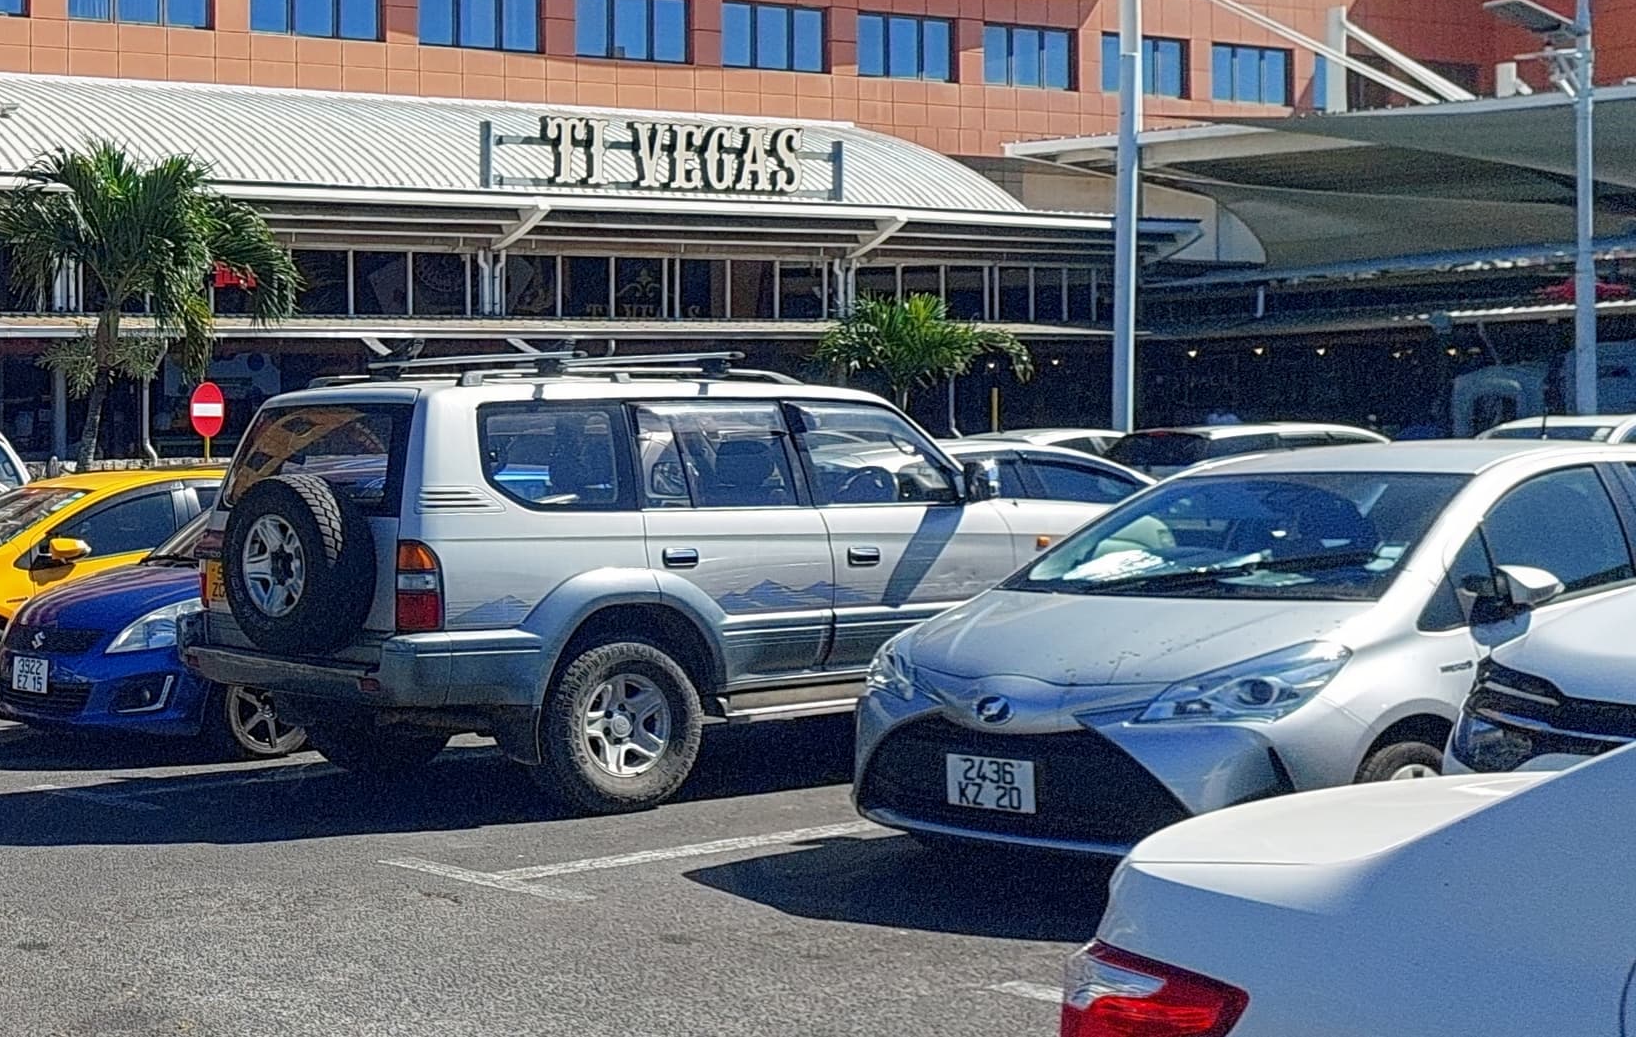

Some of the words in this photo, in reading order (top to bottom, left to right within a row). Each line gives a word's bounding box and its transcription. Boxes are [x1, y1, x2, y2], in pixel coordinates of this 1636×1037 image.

[541, 115, 610, 187] TI
[627, 121, 805, 193] VEGAS
[18, 658, 43, 675] 3922
[17, 674, 29, 690] EZ
[33, 675, 43, 692] 15
[962, 757, 1015, 785] 2436
[957, 781, 984, 807] KZ
[994, 785, 1022, 810] 20
